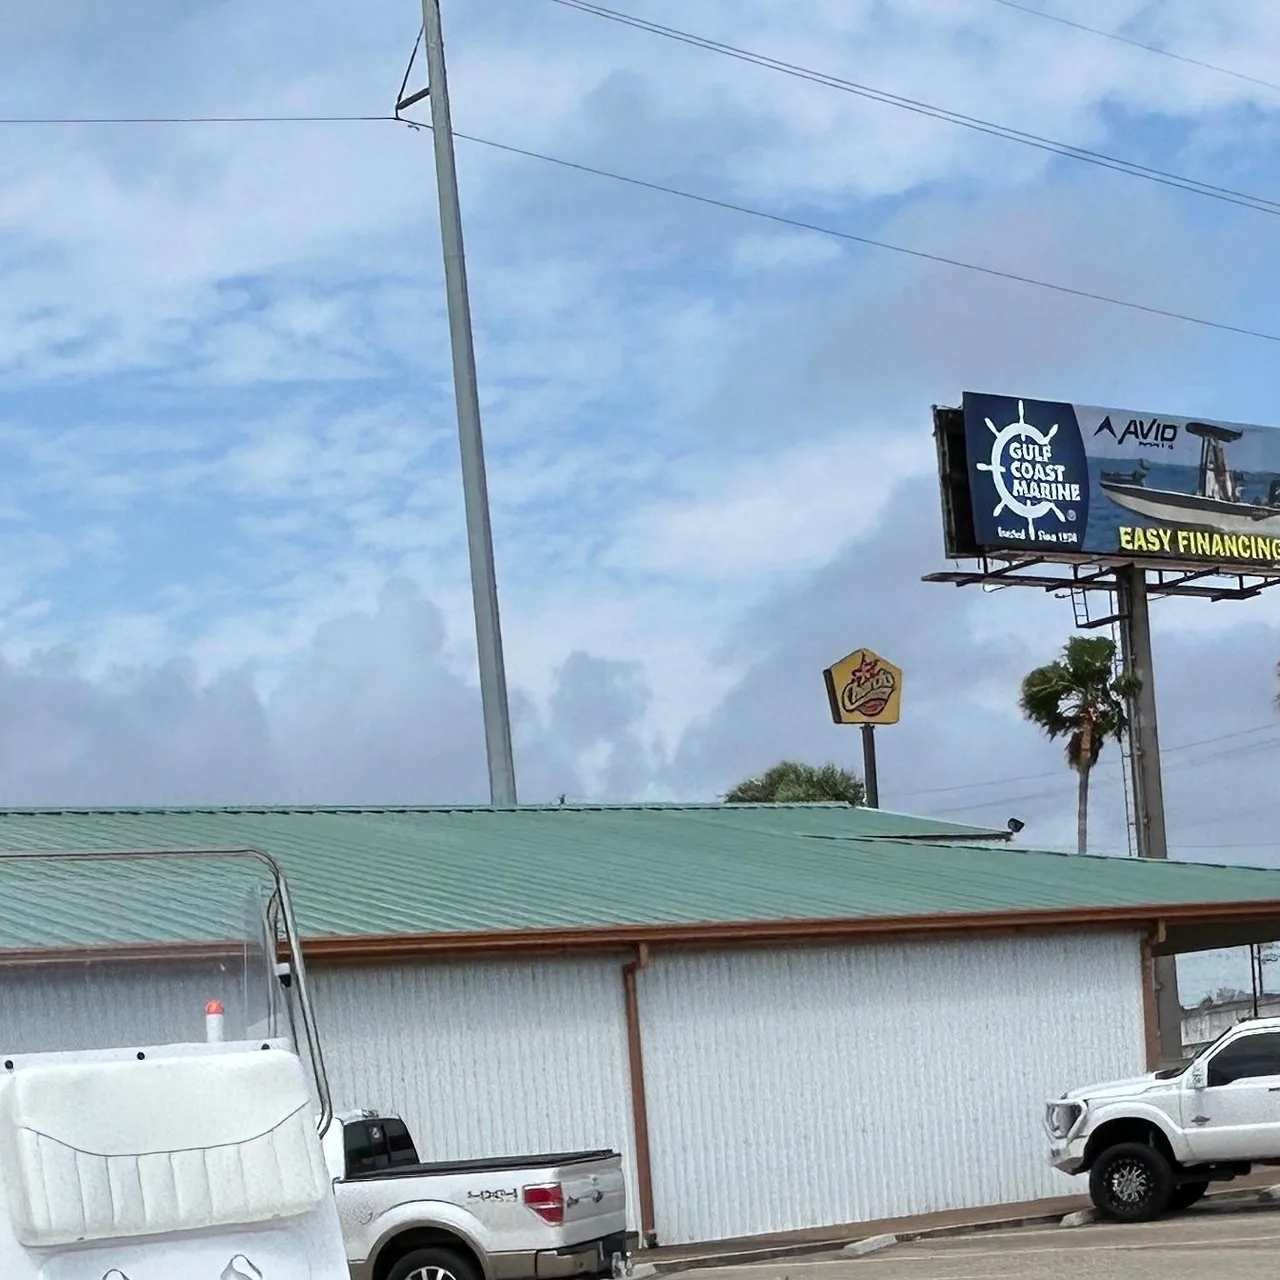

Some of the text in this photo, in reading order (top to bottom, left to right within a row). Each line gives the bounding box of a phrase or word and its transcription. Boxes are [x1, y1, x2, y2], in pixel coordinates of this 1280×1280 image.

[1118, 418, 1179, 445] AVID
[1009, 441, 1052, 462] GULF
[1010, 460, 1066, 482] COAST
[1011, 478, 1081, 501] MARINE
[1119, 526, 1172, 552] EASY
